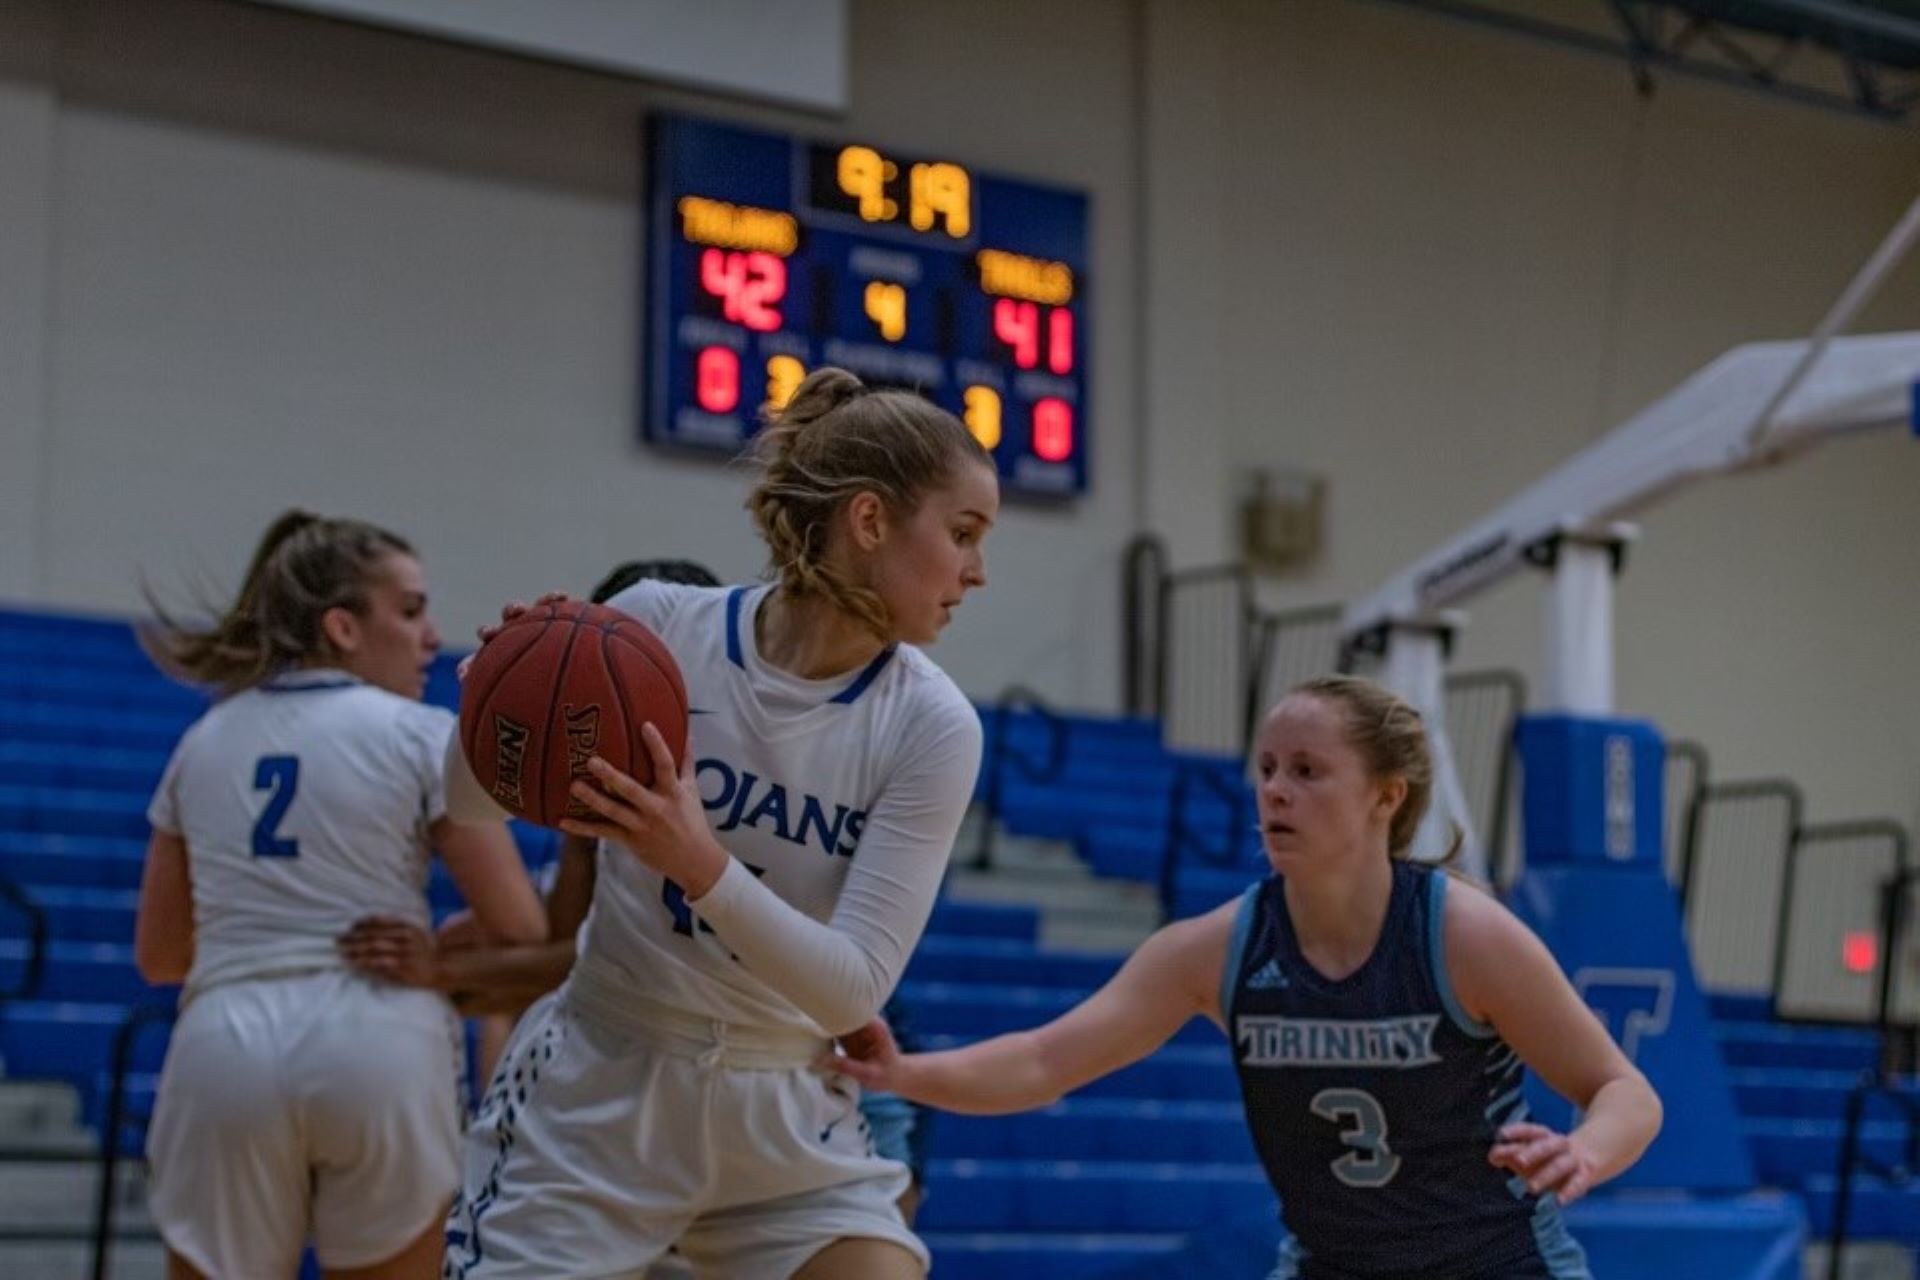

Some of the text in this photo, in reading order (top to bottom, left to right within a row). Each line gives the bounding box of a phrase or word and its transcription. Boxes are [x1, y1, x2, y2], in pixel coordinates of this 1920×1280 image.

[838, 146, 970, 238] 9:19
[701, 247, 786, 332] 42
[864, 281, 906, 341] 4
[994, 299, 1073, 375] 41
[697, 346, 740, 413] 0
[1032, 396, 1073, 463] 0
[252, 756, 299, 859] 2
[695, 758, 868, 858] OJANS
[1239, 1015, 1442, 1067] TRINITY
[1310, 1088, 1400, 1187] 3
